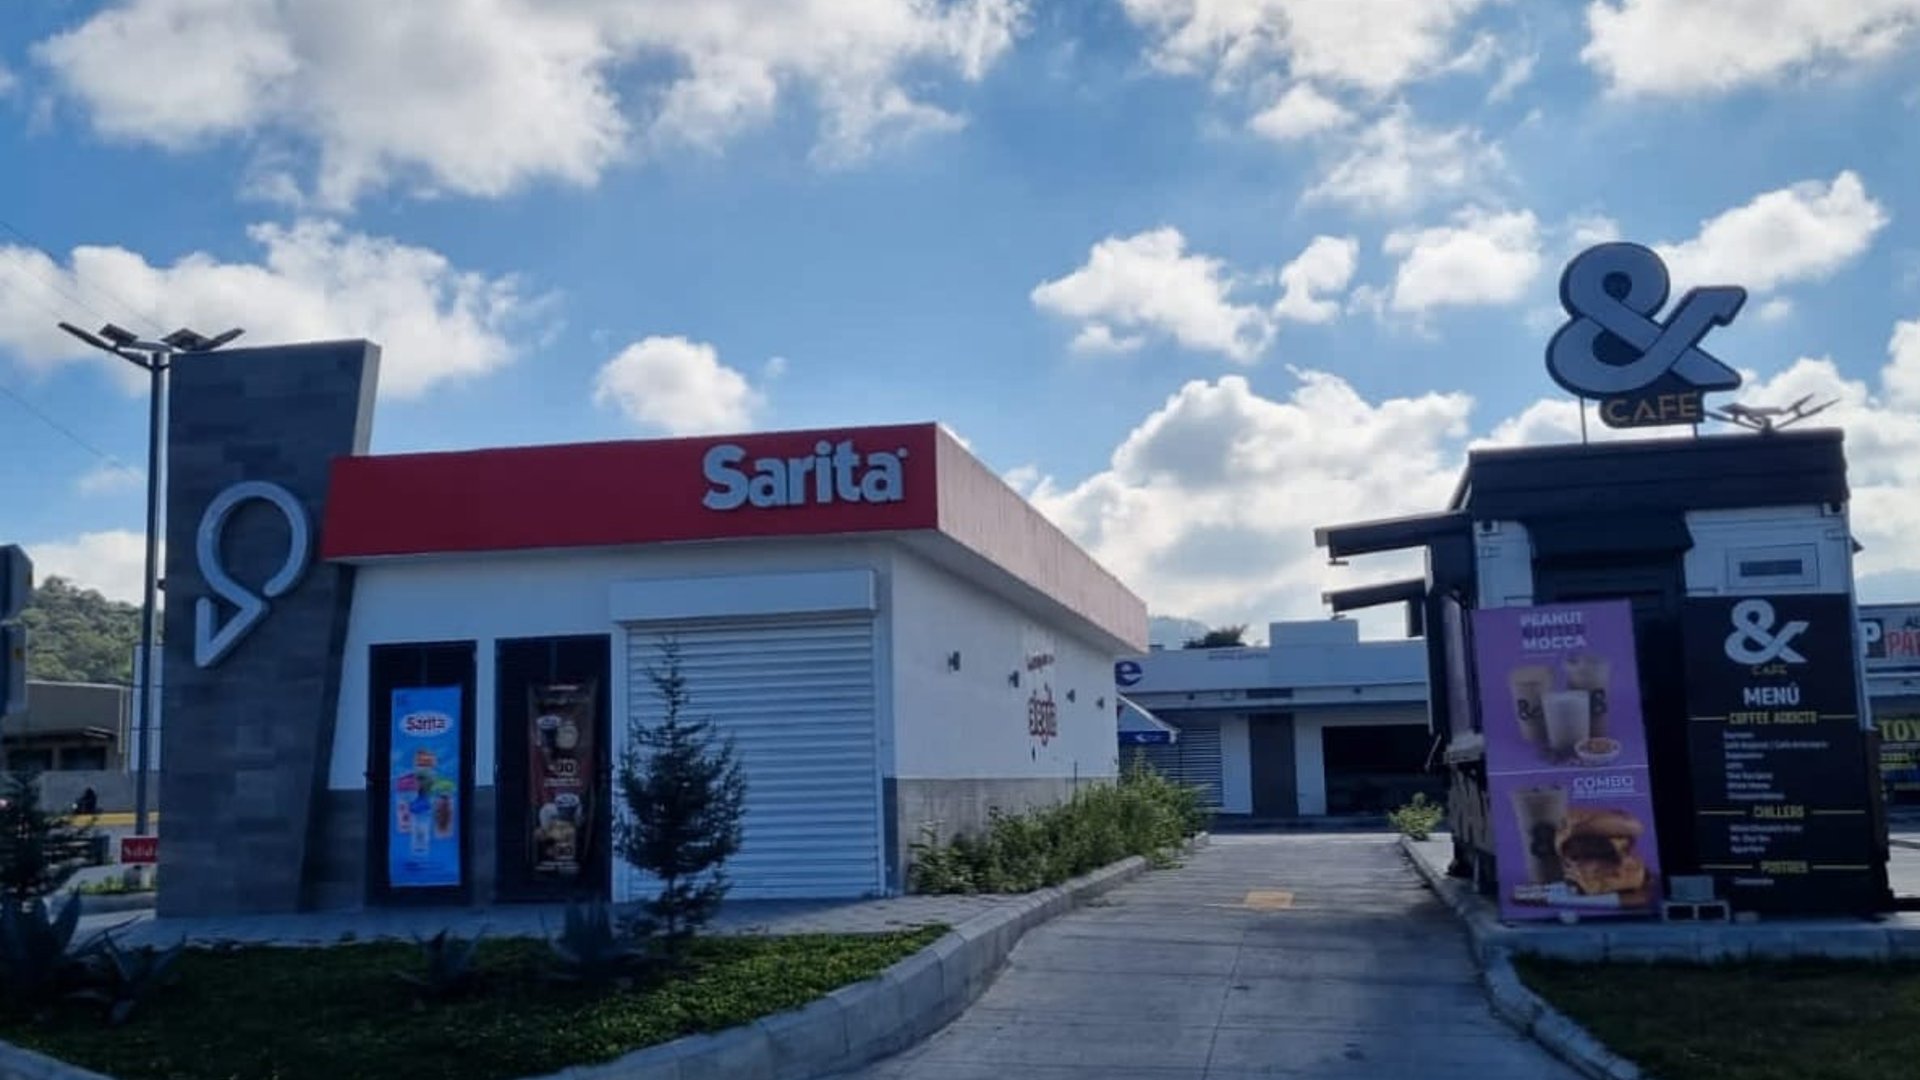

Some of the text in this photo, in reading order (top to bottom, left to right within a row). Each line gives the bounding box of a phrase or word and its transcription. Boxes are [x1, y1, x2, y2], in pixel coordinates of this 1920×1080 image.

[1546, 241, 1748, 400] &
[702, 439, 908, 510] Sarita
[1520, 611, 1582, 627] PEANUT
[1724, 598, 1810, 665] &
[1523, 635, 1588, 650] MOCCA
[1742, 681, 1800, 706] MENÚ
[405, 716, 447, 732] Sarita
[1573, 776, 1634, 789] COMBO
